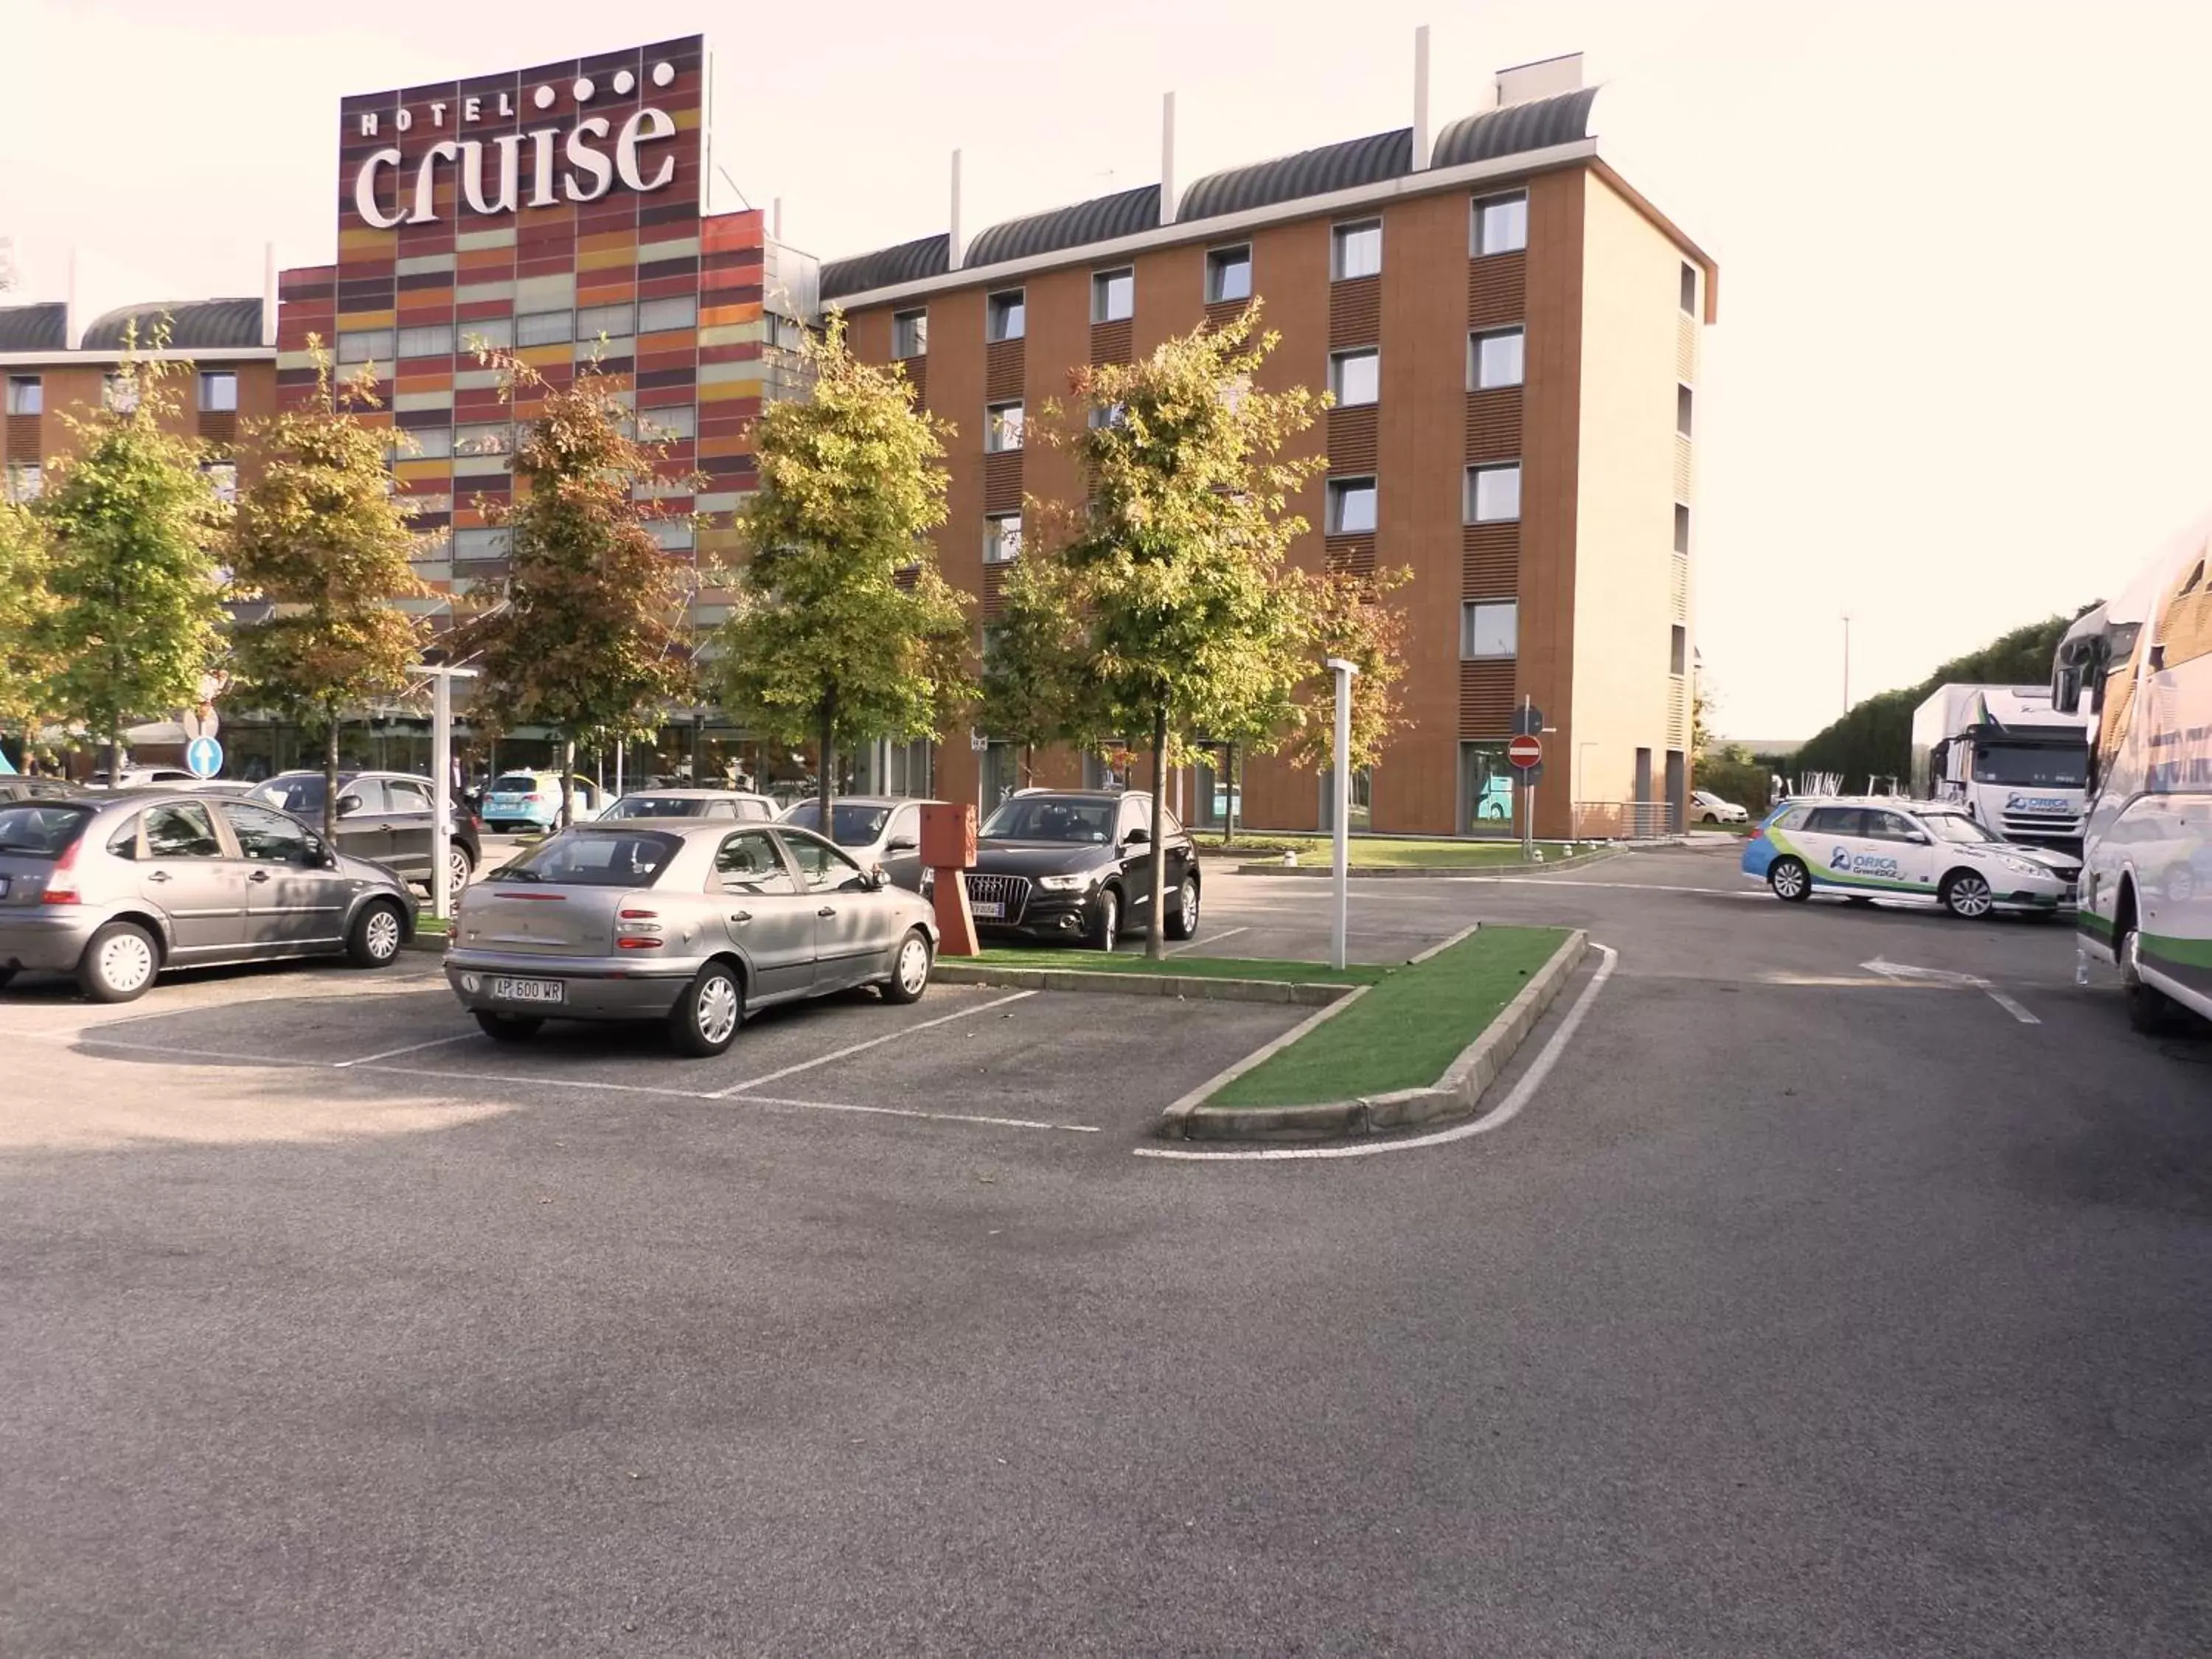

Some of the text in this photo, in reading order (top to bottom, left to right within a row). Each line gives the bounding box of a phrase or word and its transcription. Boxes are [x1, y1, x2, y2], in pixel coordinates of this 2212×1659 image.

[361, 93, 514, 136] HOTEL
[1854, 856, 1897, 869] ORICA
[518, 981, 539, 998] 600
[544, 983, 560, 998] WR
